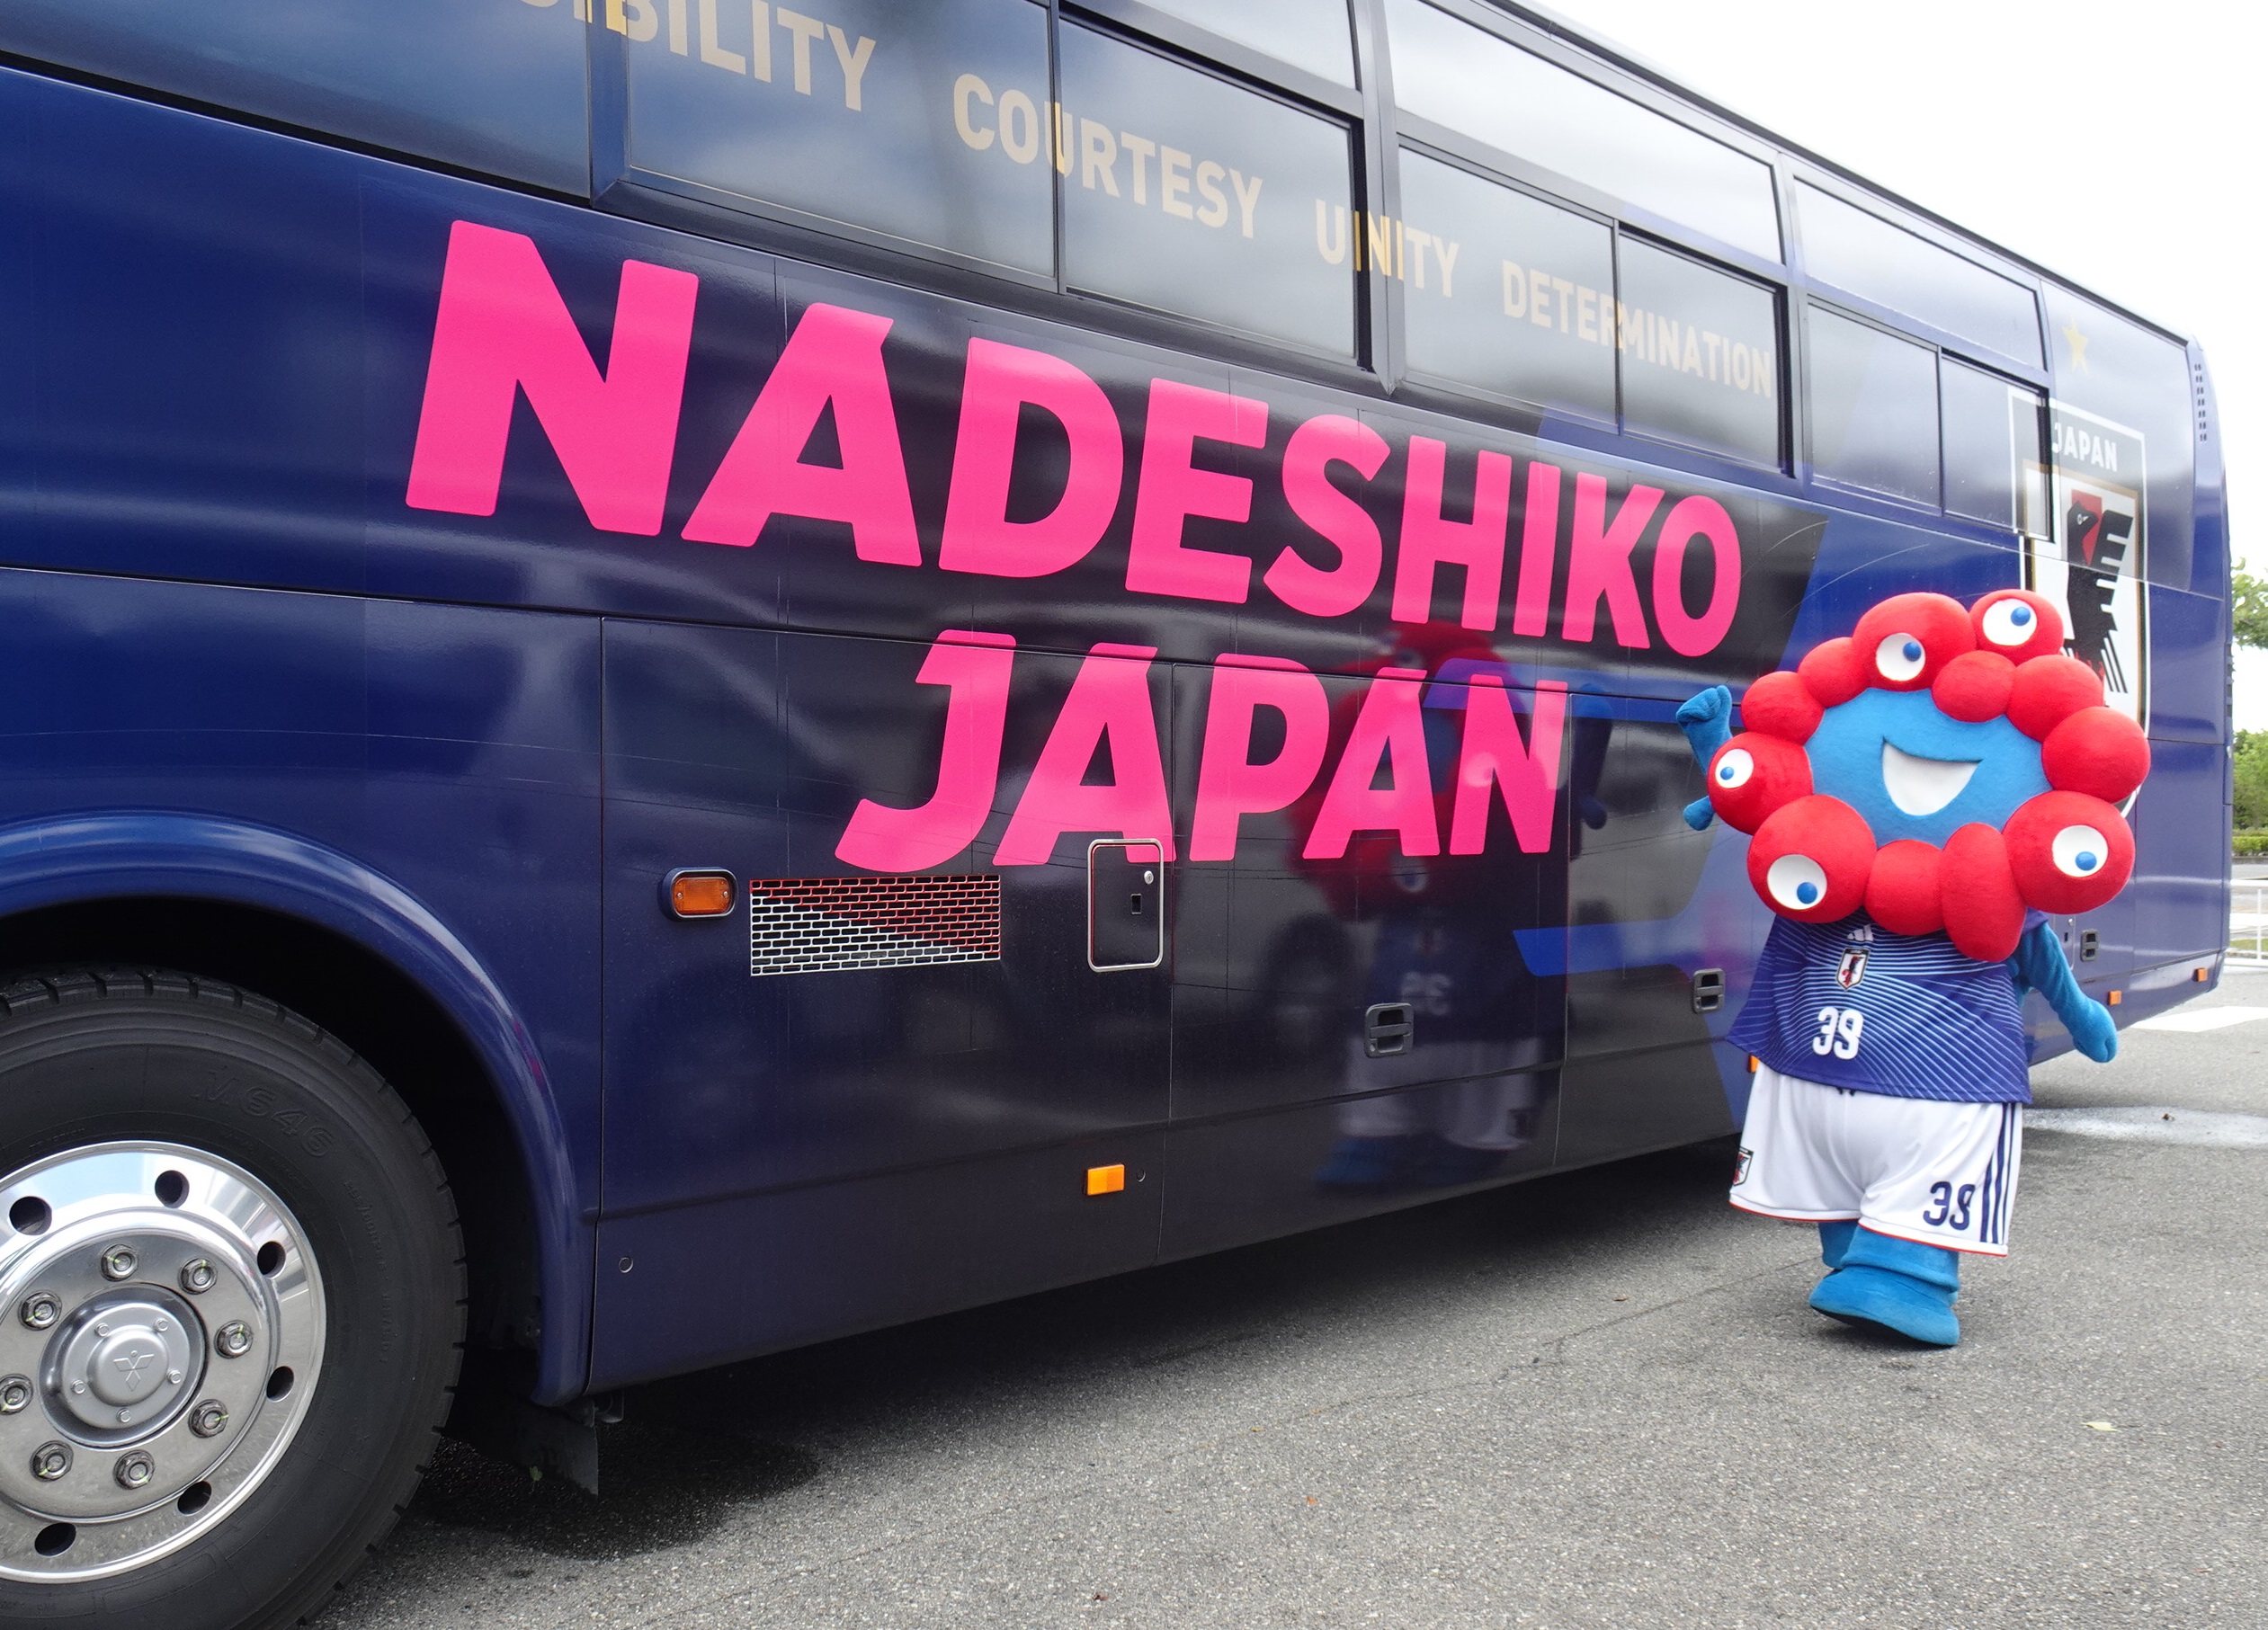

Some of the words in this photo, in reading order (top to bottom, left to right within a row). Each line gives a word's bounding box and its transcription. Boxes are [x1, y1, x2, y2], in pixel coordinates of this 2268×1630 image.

[953, 74, 1263, 239] COURTESY
[1316, 198, 1460, 298] UNITY
[1501, 260, 1772, 398] DETERMINATION
[406, 220, 1742, 657] NADESHIKO
[2051, 423, 2118, 472] JAPAN
[835, 629, 1568, 872] JAPAN
[1812, 1007, 1864, 1060] 39
